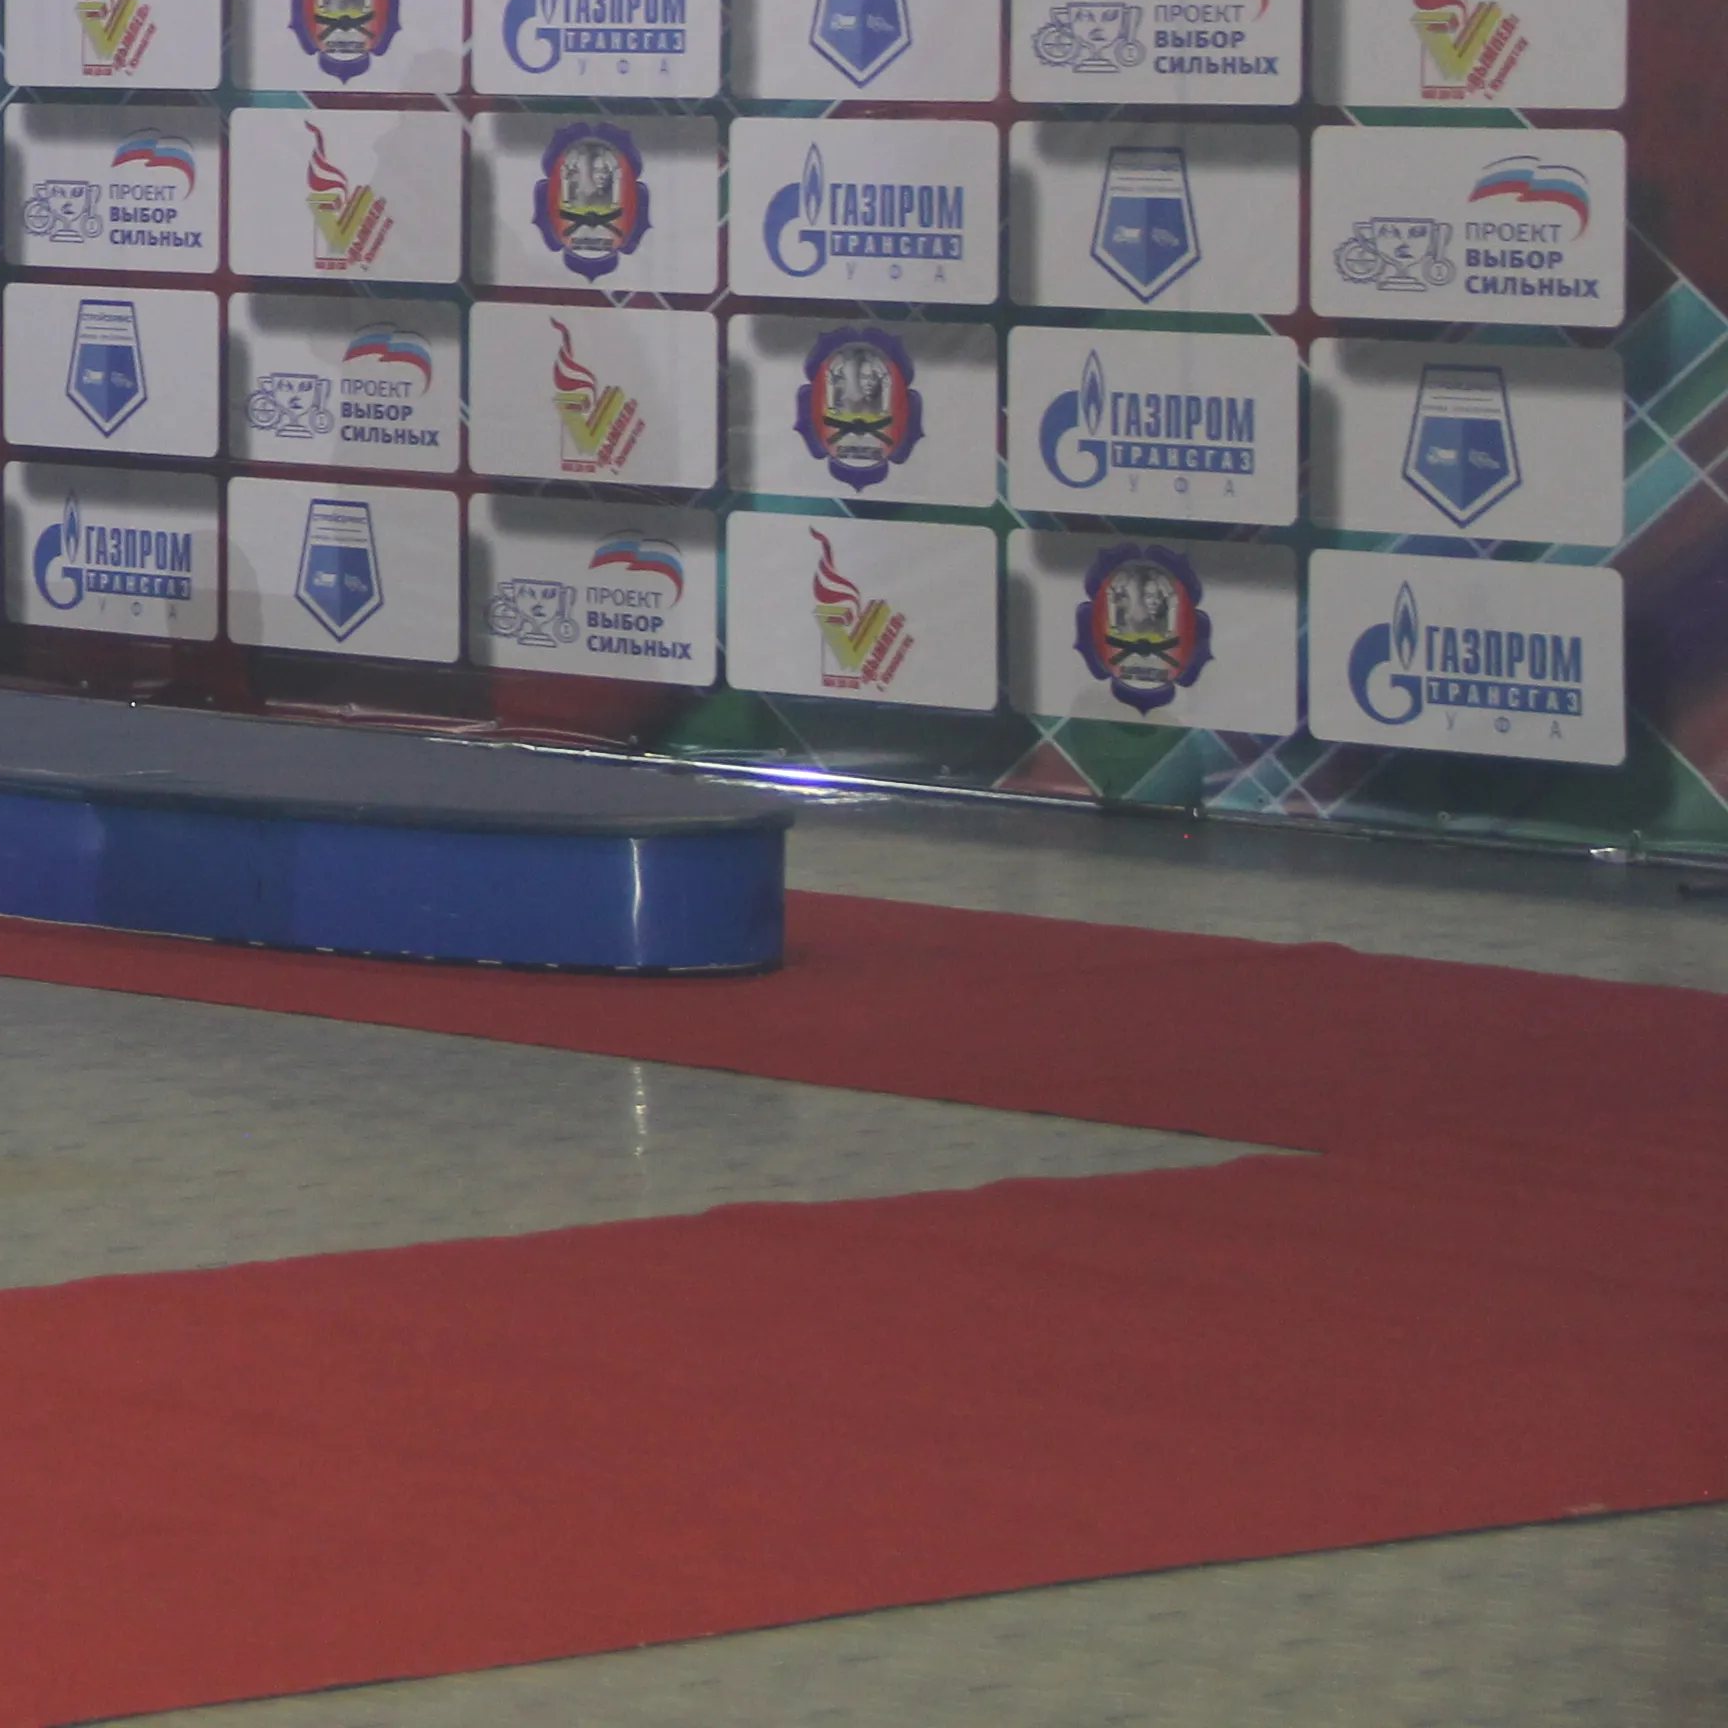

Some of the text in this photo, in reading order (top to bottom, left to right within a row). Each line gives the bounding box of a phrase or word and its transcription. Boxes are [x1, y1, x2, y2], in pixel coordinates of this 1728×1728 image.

[1153, 4, 1245, 24] ПРОЕКТ
[566, 30, 686, 53] ТРАНСГАЗ
[1153, 30, 1246, 50] ВЫБОР
[1153, 56, 1279, 76] СИЛЬНЫХ
[109, 183, 176, 202] ПРОЕКТ
[109, 206, 179, 225] ВЫБОР
[829, 182, 964, 229] ГАЗПРОМ
[109, 228, 204, 249] СИЛЬНЫХ
[1465, 221, 1563, 244] ПРОЕКТ
[832, 233, 963, 259] ТРАНСГАЗ
[1465, 248, 1564, 270] ВЫБОР
[1465, 274, 1601, 300] СИЛЬНЫХ
[340, 378, 413, 399] ПРОЕКТ
[340, 401, 413, 422] ВЫБОР
[1110, 391, 1255, 443] ГАЗПРОМ
[340, 424, 440, 448] СИЛЬНЫХ
[1113, 444, 1254, 472] ТРАНСГАЗ
[84, 524, 193, 573] ГАЗПРОМ
[585, 585, 664, 609] ПРОЕКТ
[586, 611, 664, 634] ВЫБОР
[586, 636, 693, 661] СИЛЬНЫХ
[1425, 625, 1582, 683] ГАЗПРОМ
[1429, 681, 1581, 714] ТРАНСГАЗ
[1444, 712, 1563, 740] УФА
